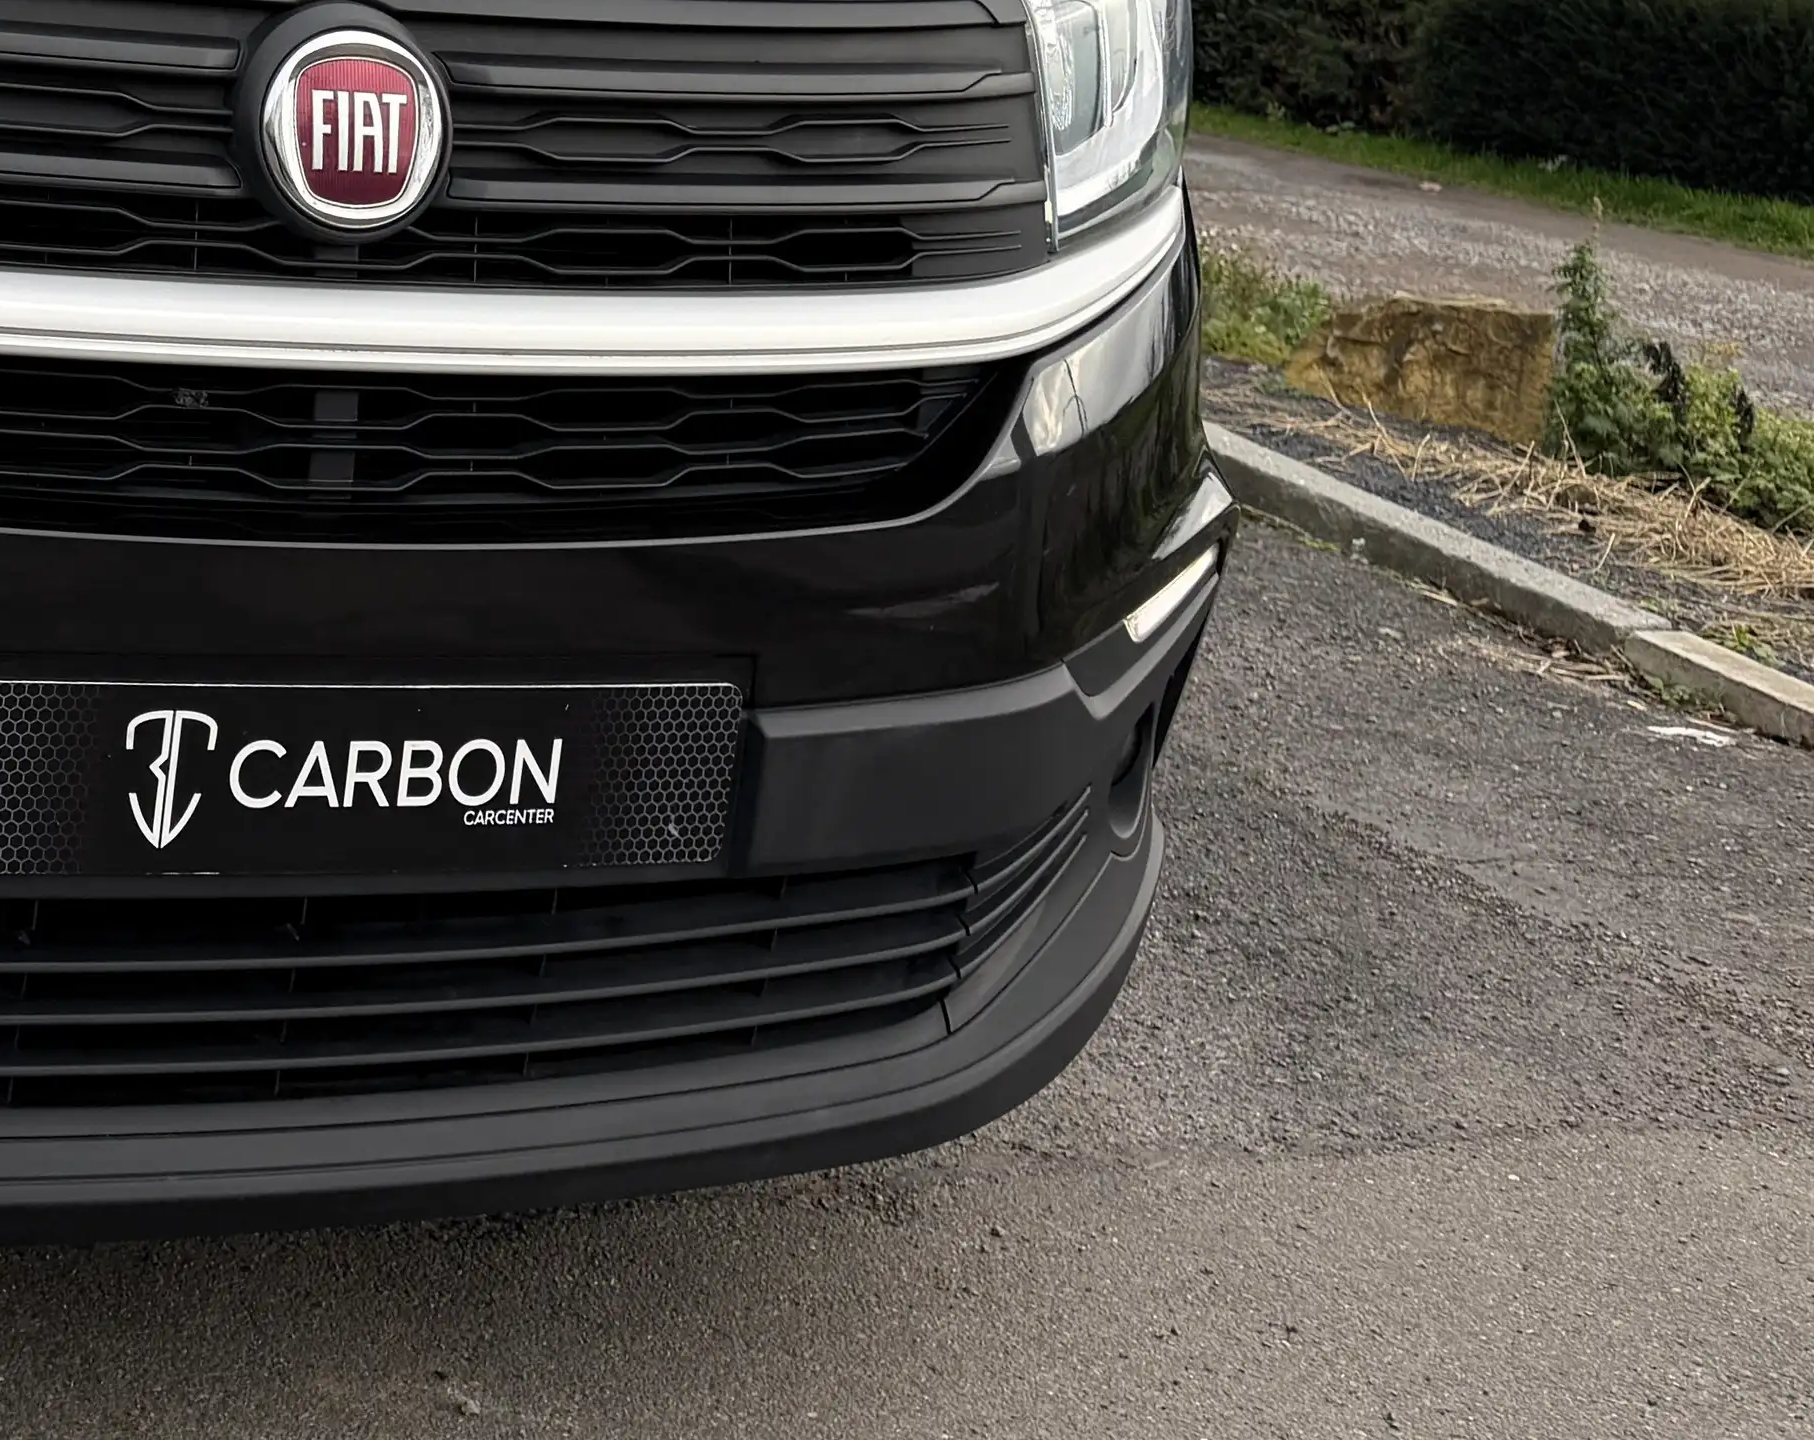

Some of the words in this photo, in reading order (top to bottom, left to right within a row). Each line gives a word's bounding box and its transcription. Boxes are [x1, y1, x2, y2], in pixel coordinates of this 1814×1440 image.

[311, 89, 407, 174] FIAT
[229, 738, 563, 809] CARBON
[463, 808, 555, 826] CARCENTER
